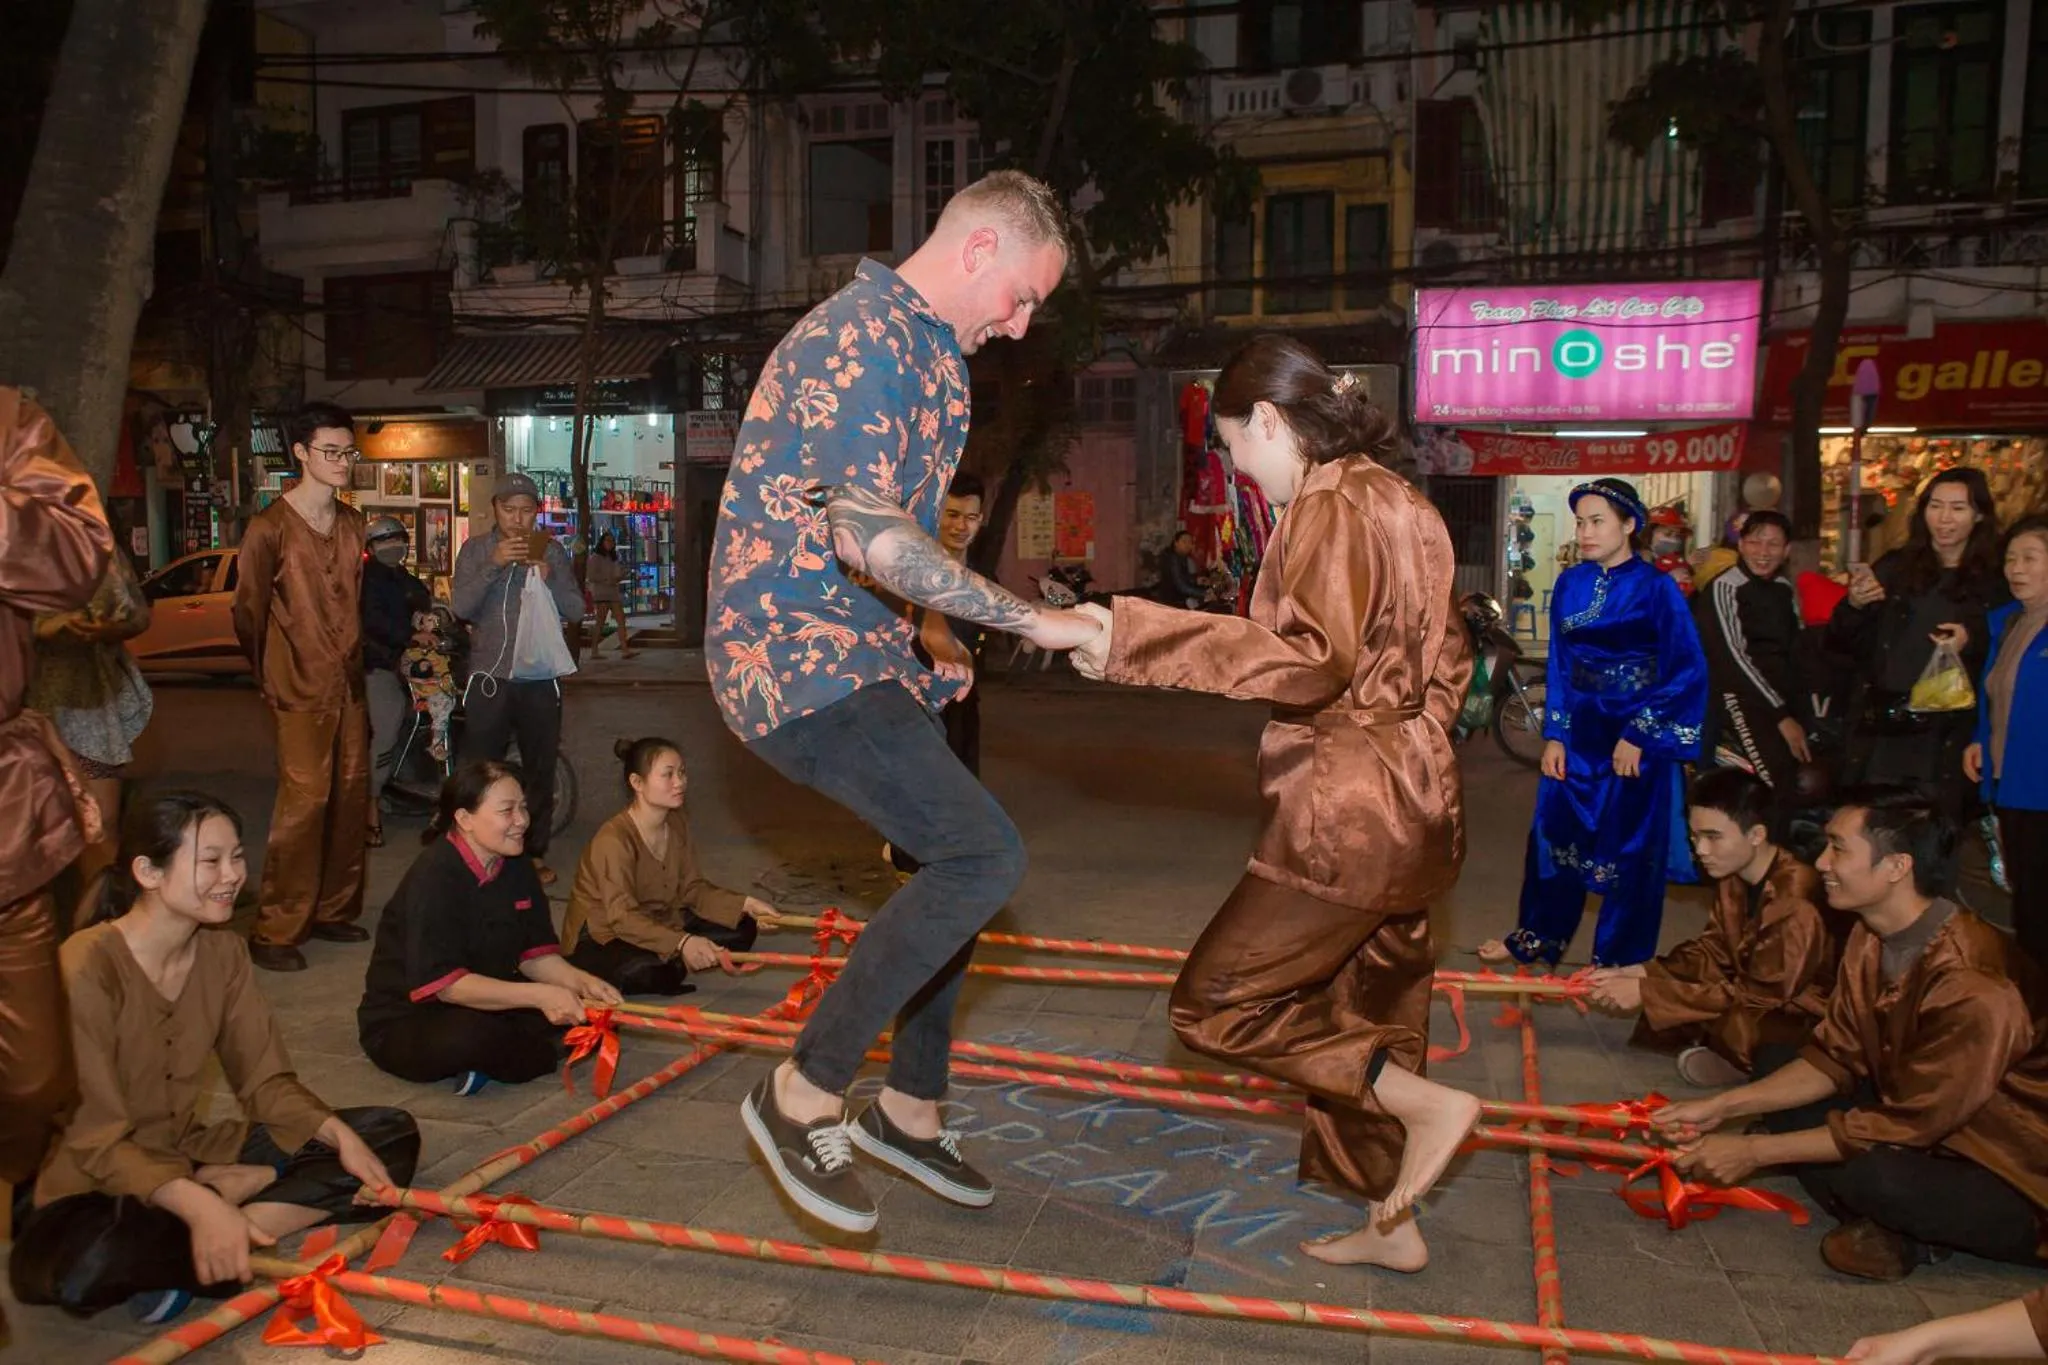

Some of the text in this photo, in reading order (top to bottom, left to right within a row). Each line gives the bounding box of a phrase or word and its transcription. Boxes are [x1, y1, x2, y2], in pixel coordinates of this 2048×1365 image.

[1470, 300, 1525, 323] Trang
[1618, 297, 1658, 318] Cao
[1433, 405, 1450, 416] 24
[1522, 442, 1581, 470] Sale
